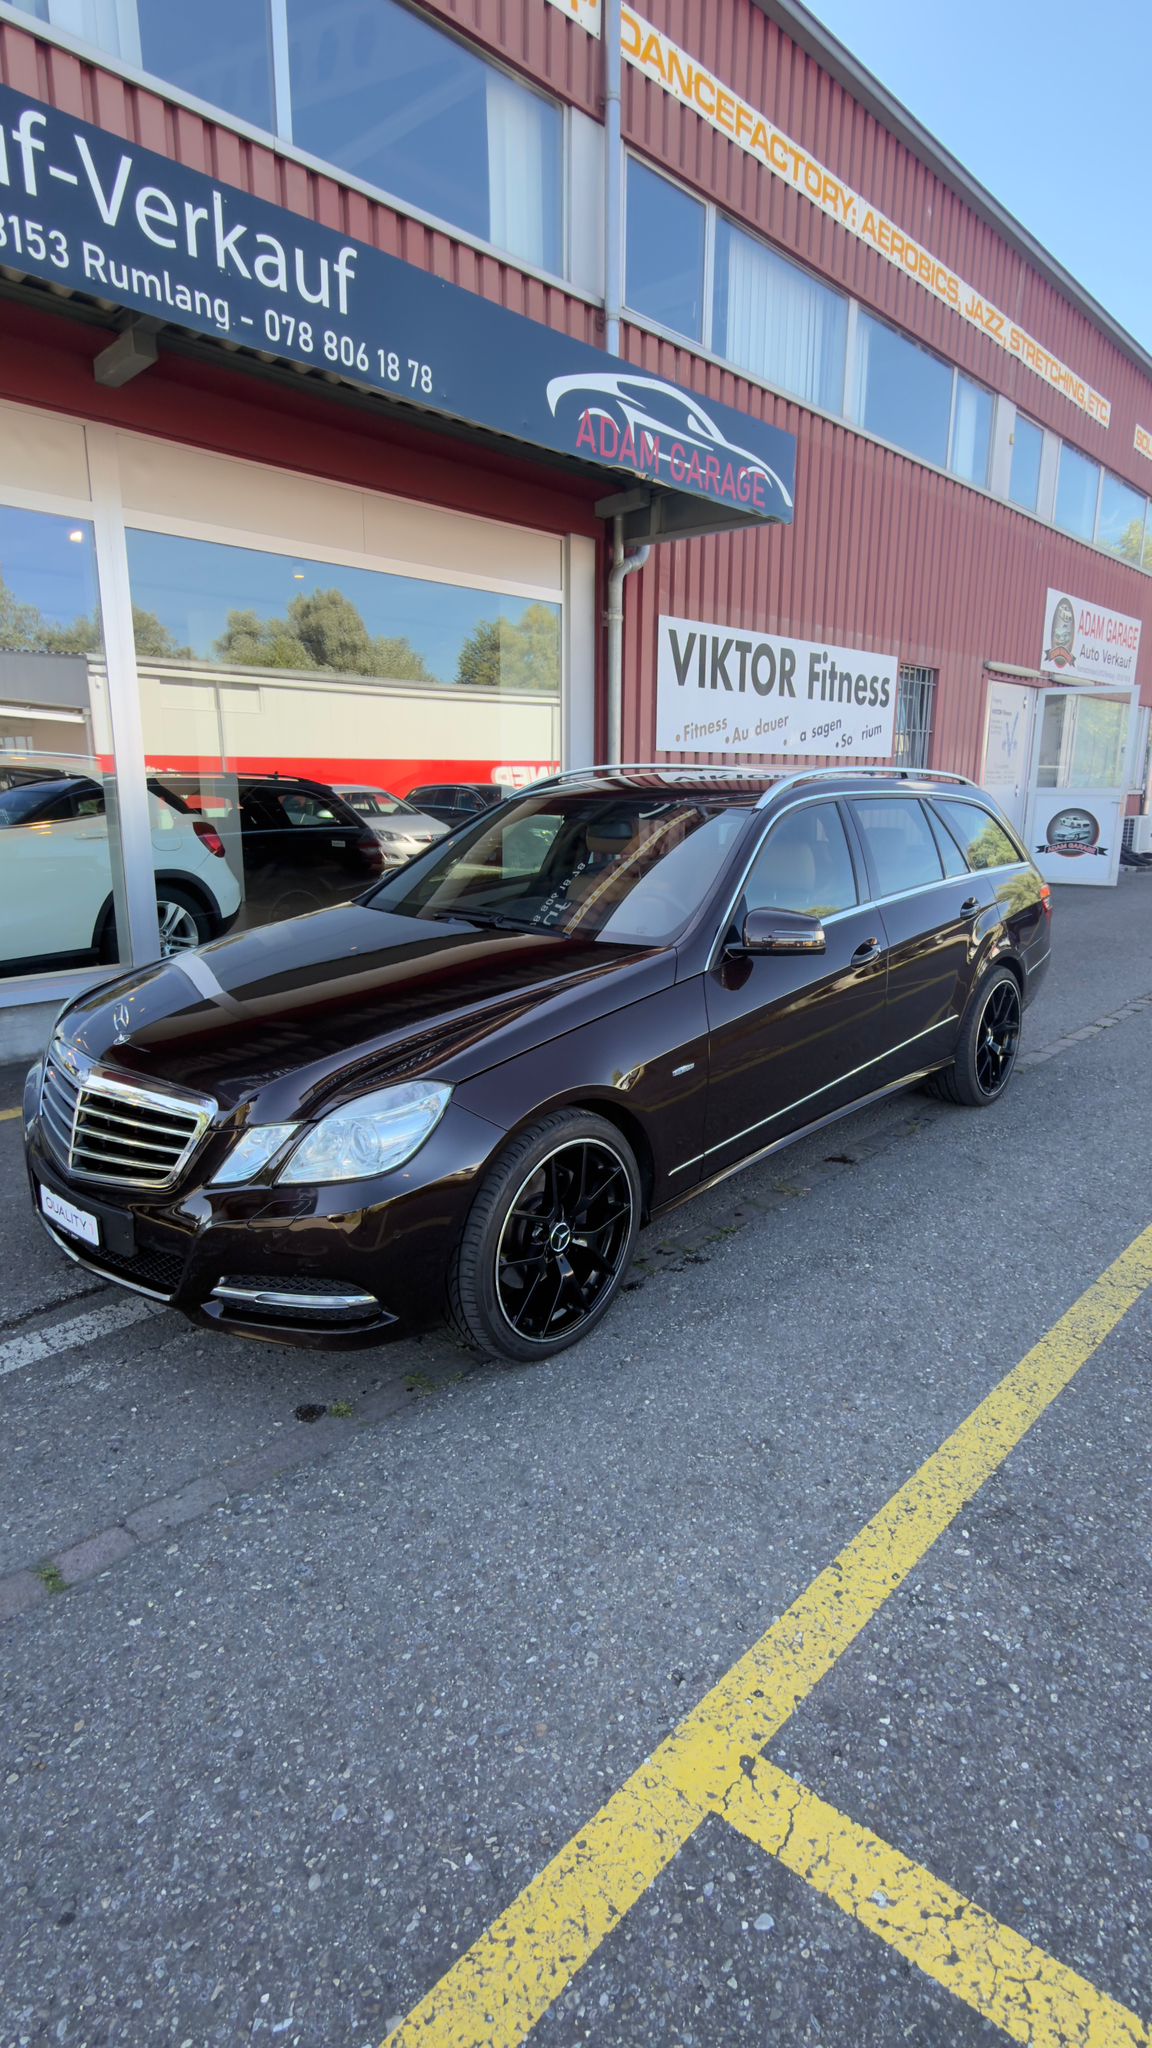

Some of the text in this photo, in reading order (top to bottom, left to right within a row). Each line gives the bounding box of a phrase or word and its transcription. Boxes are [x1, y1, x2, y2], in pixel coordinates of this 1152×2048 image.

[0, 110, 358, 315] f-Verkauf
[621, 10, 1109, 424] DANCEFACTORY: AEROBICS, JAZZ, STRETCHING, ETC.
[82, 241, 230, 332] Rumlang
[264, 309, 314, 353] 078
[324, 330, 369, 371] 806
[377, 349, 400, 382] 18
[408, 359, 433, 393] 78
[575, 407, 766, 508] ADAM GARAGE
[668, 629, 891, 708] VIKTOR Fitness
[1078, 609, 1139, 651] ADAM GARAGE
[1080, 643, 1100, 662] Auto
[1102, 649, 1132, 669] Verkauf
[683, 717, 728, 742] Fitness
